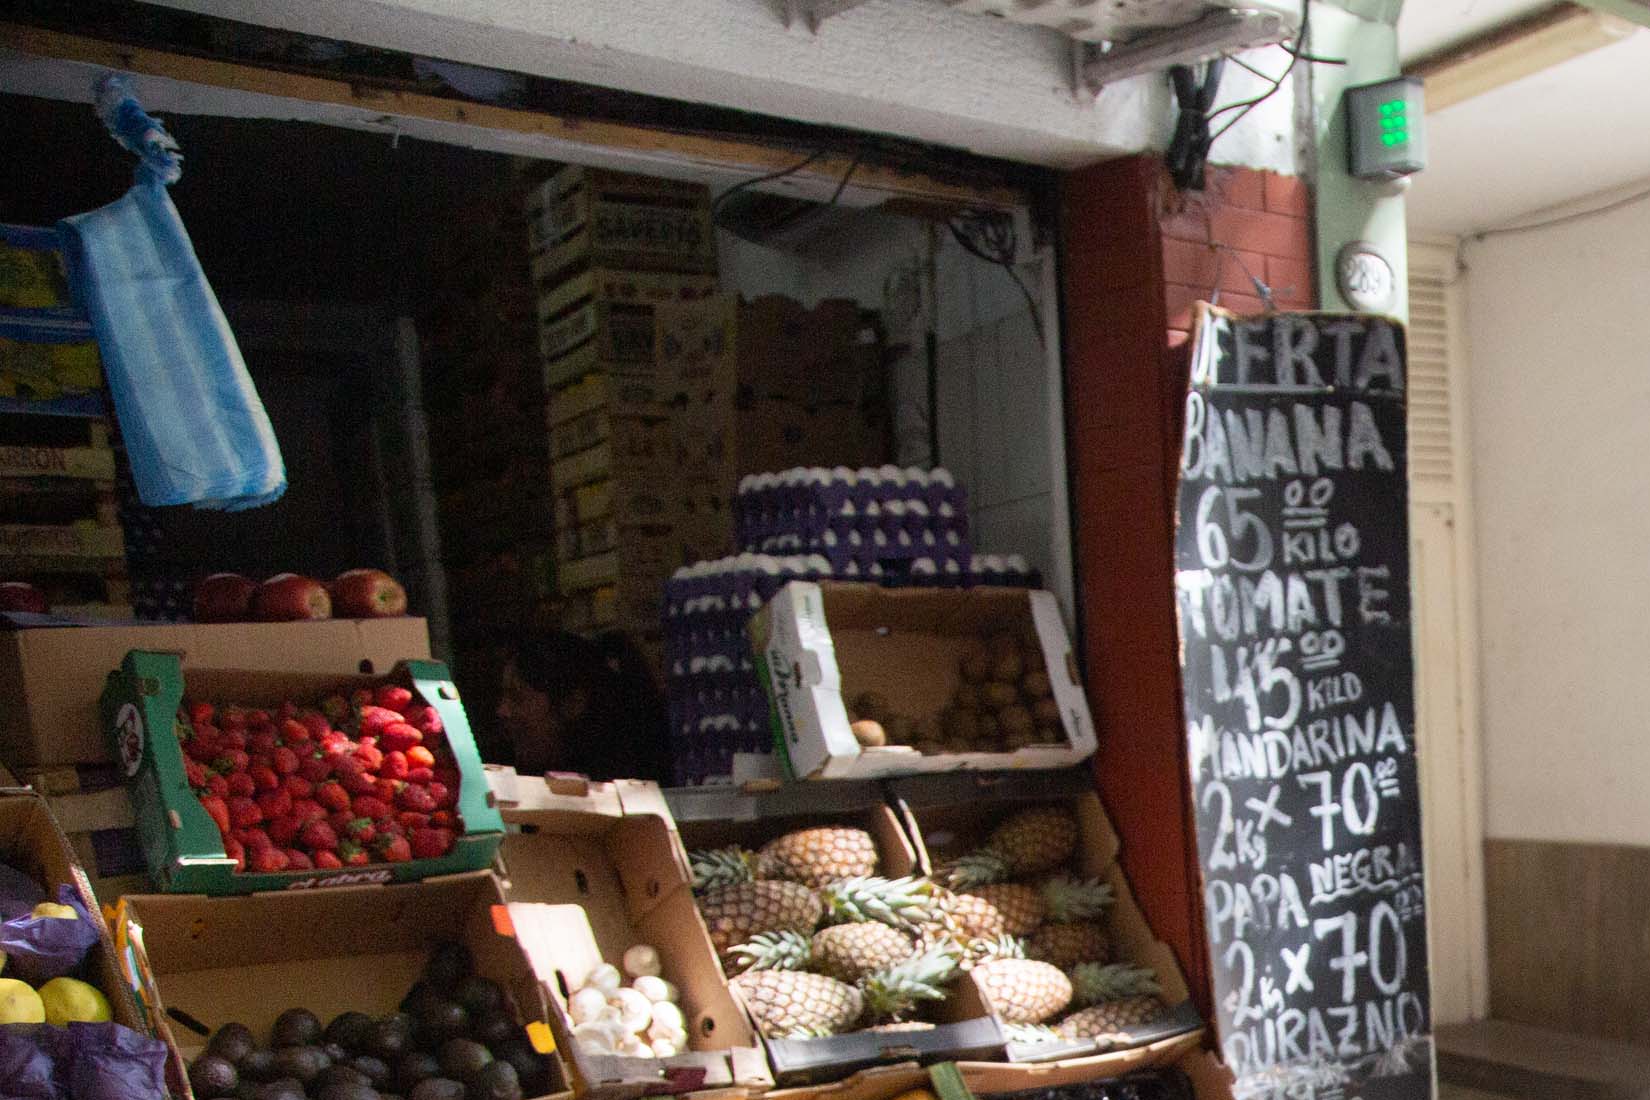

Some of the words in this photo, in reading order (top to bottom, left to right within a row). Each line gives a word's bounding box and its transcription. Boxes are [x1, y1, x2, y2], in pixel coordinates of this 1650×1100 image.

[1181, 391, 1394, 482] BANANA
[1195, 484, 1273, 571] 65
[1282, 522, 1361, 566] KILO
[1176, 564, 1394, 641] TOMATE
[1306, 671, 1363, 712] KILO
[1186, 701, 1408, 784] MANDARINA
[1202, 780, 1237, 872] 2
[1296, 760, 1380, 852] 70
[1206, 871, 1310, 944] PAPA
[1313, 899, 1408, 1004] 70
[1224, 991, 1424, 1078] DURAZNO
